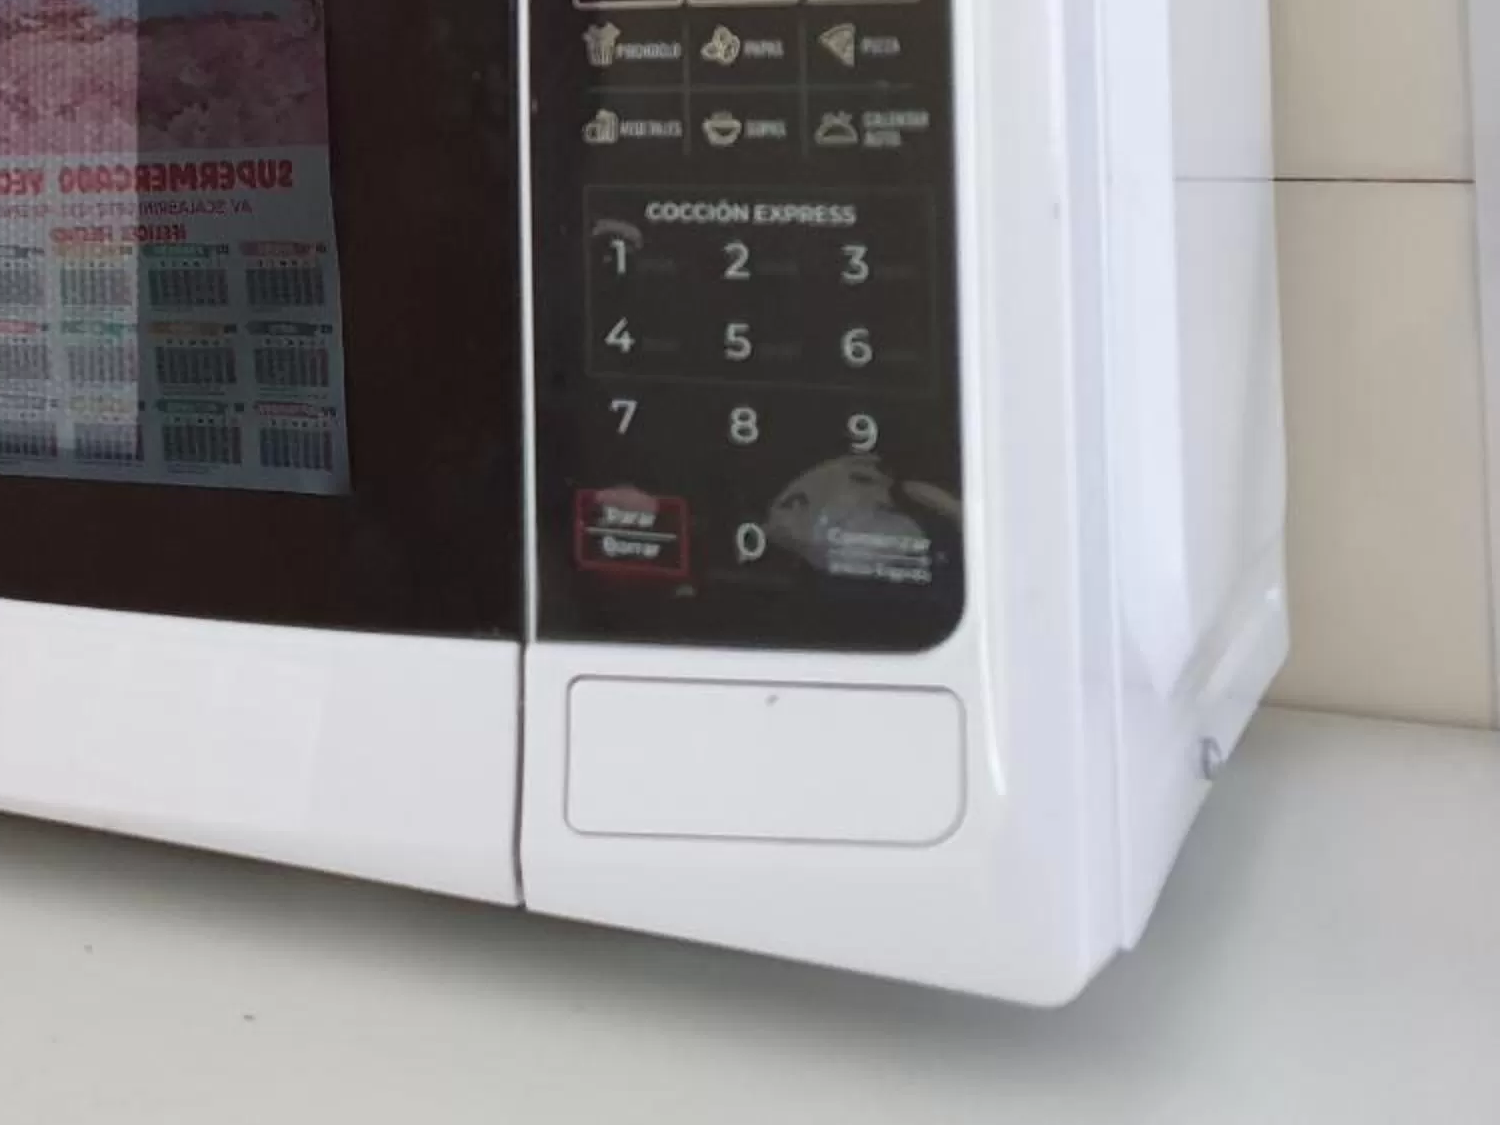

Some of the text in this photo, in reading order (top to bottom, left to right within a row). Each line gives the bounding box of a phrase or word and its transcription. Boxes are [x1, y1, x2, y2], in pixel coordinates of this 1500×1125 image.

[645, 199, 856, 226] COCCIÓN EXPRESS
[610, 240, 626, 274] 1
[724, 241, 750, 279] 2
[841, 245, 869, 284] 3
[605, 318, 634, 353] 4
[725, 323, 752, 360] 5
[842, 328, 873, 366] 6
[610, 399, 637, 434] 7
[730, 407, 759, 444] 8
[847, 414, 878, 452] 9
[737, 522, 766, 560] 0
